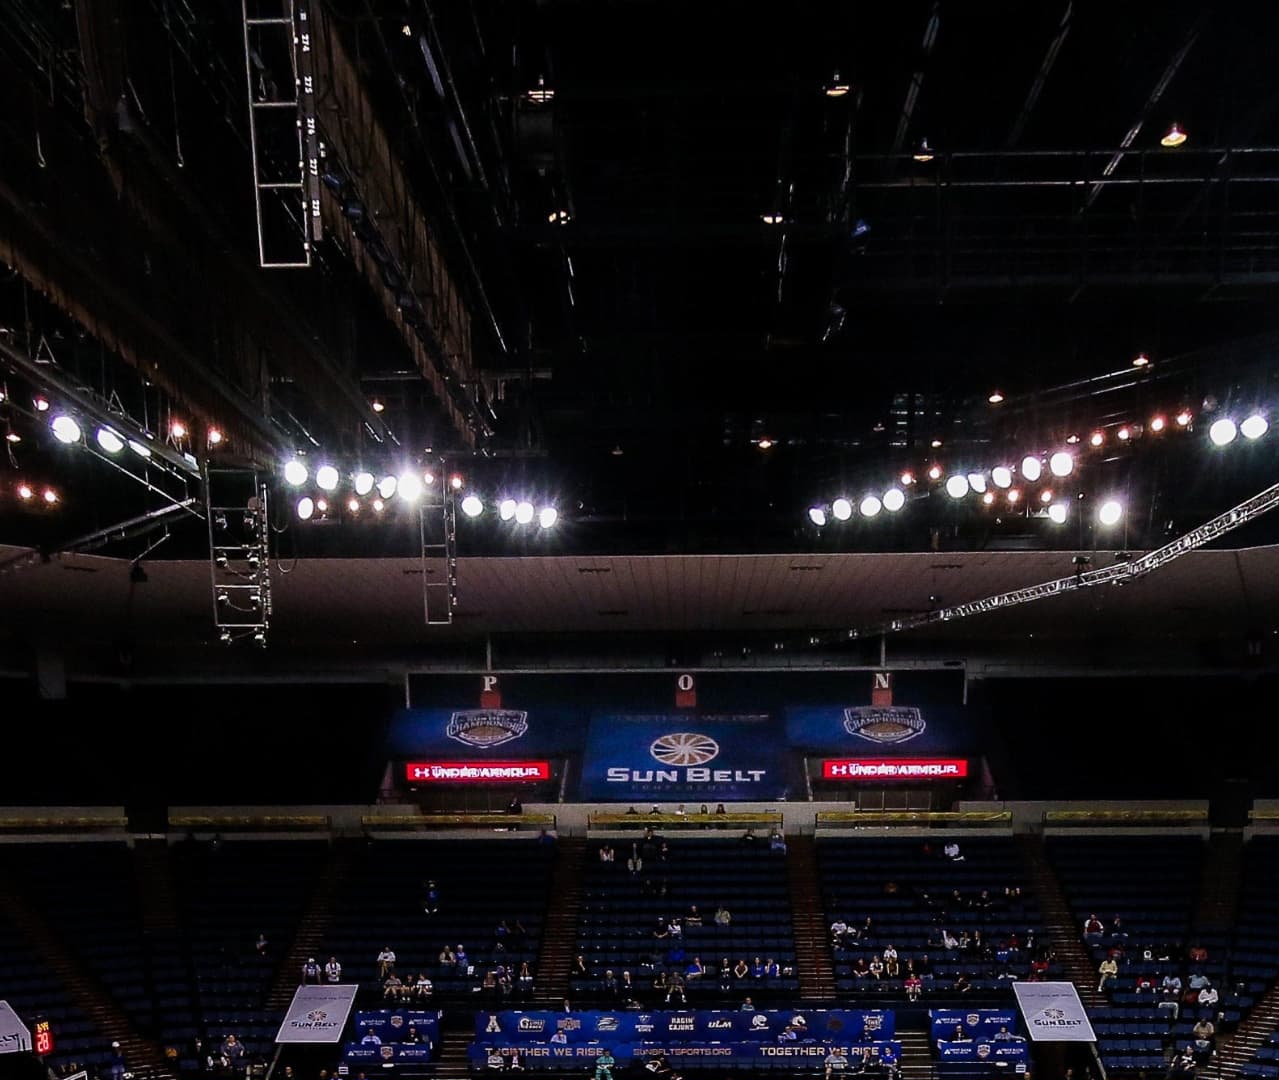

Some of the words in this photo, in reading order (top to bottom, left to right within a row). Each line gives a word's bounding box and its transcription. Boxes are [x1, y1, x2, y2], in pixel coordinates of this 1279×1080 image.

[483, 675, 498, 691] P
[678, 674, 694, 690] O
[874, 672, 890, 689] N
[607, 767, 678, 782] SUN
[686, 767, 766, 782] BELT
[37, 1034, 49, 1052] 28
[553, 1048, 573, 1057] WE
[576, 1047, 604, 1056] RISE
[760, 1047, 824, 1056] TOGETHER
